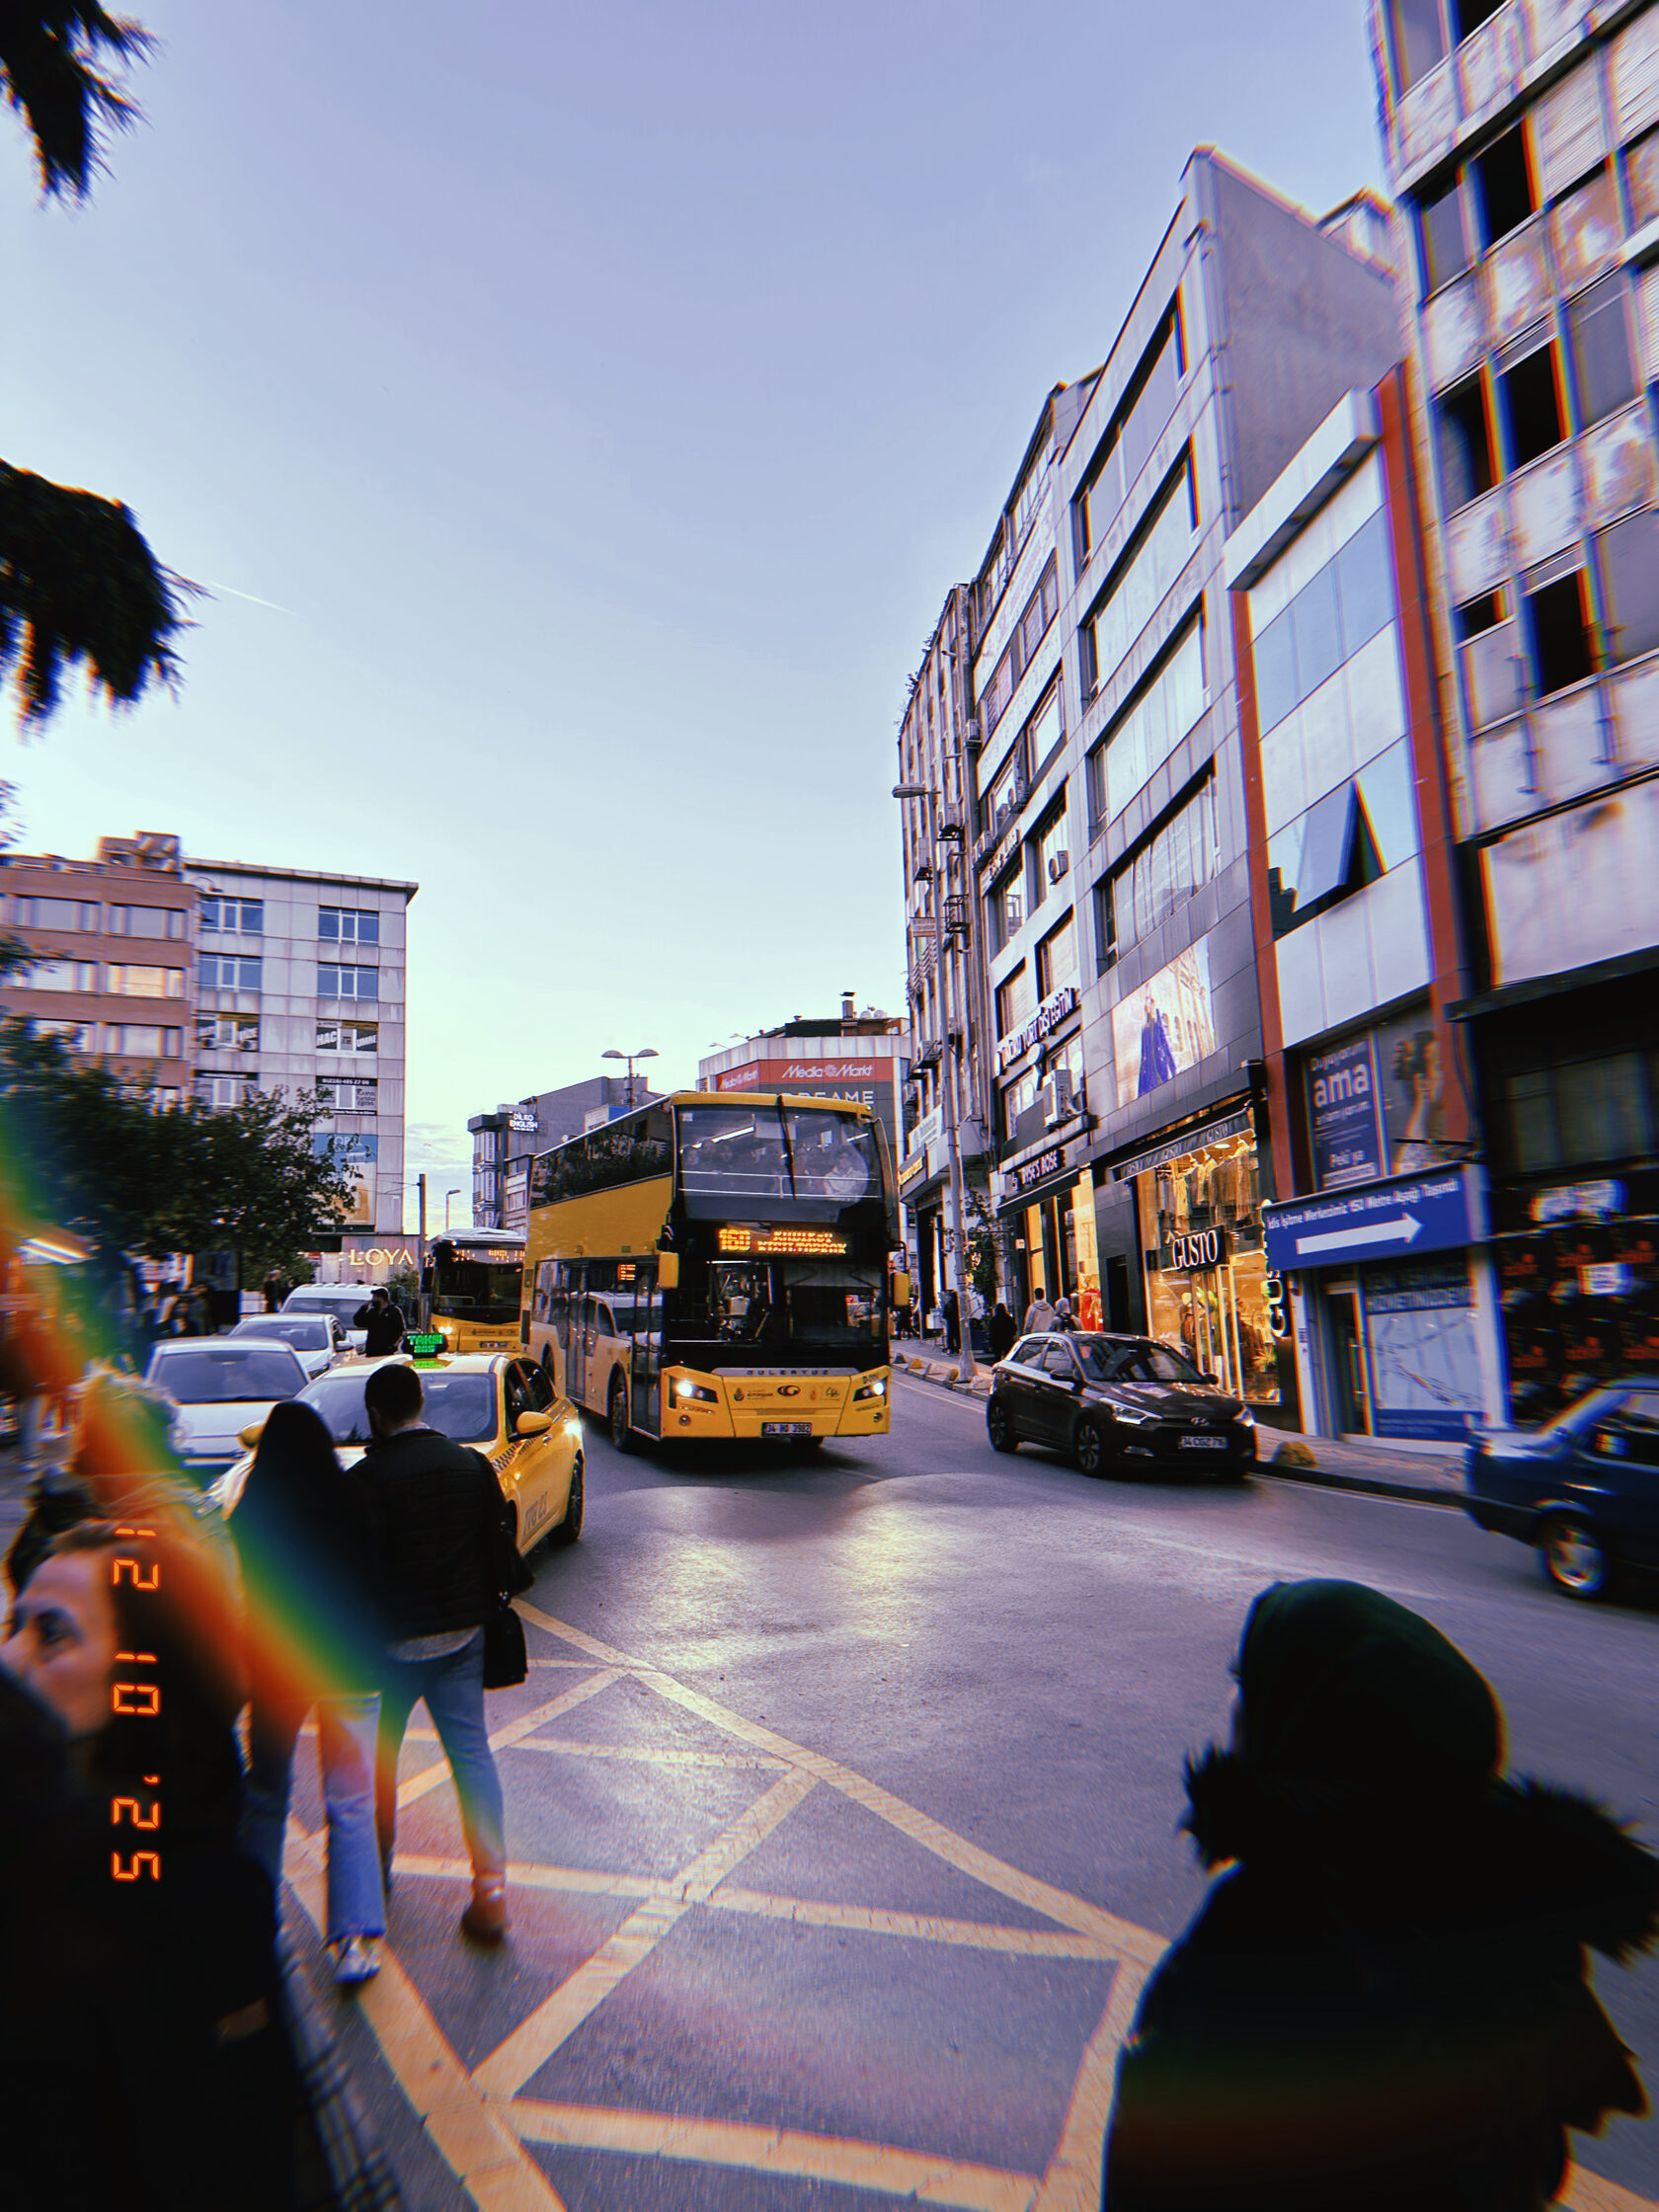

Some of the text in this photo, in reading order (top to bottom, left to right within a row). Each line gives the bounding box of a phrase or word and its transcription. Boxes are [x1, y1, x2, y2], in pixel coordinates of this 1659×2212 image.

[317, 1031, 337, 1047] HAC
[782, 1064, 874, 1079] Media Markt
[1313, 1064, 1371, 1108] ama
[1172, 1229, 1219, 1269] GUSTO
[766, 1424, 776, 1433] 34
